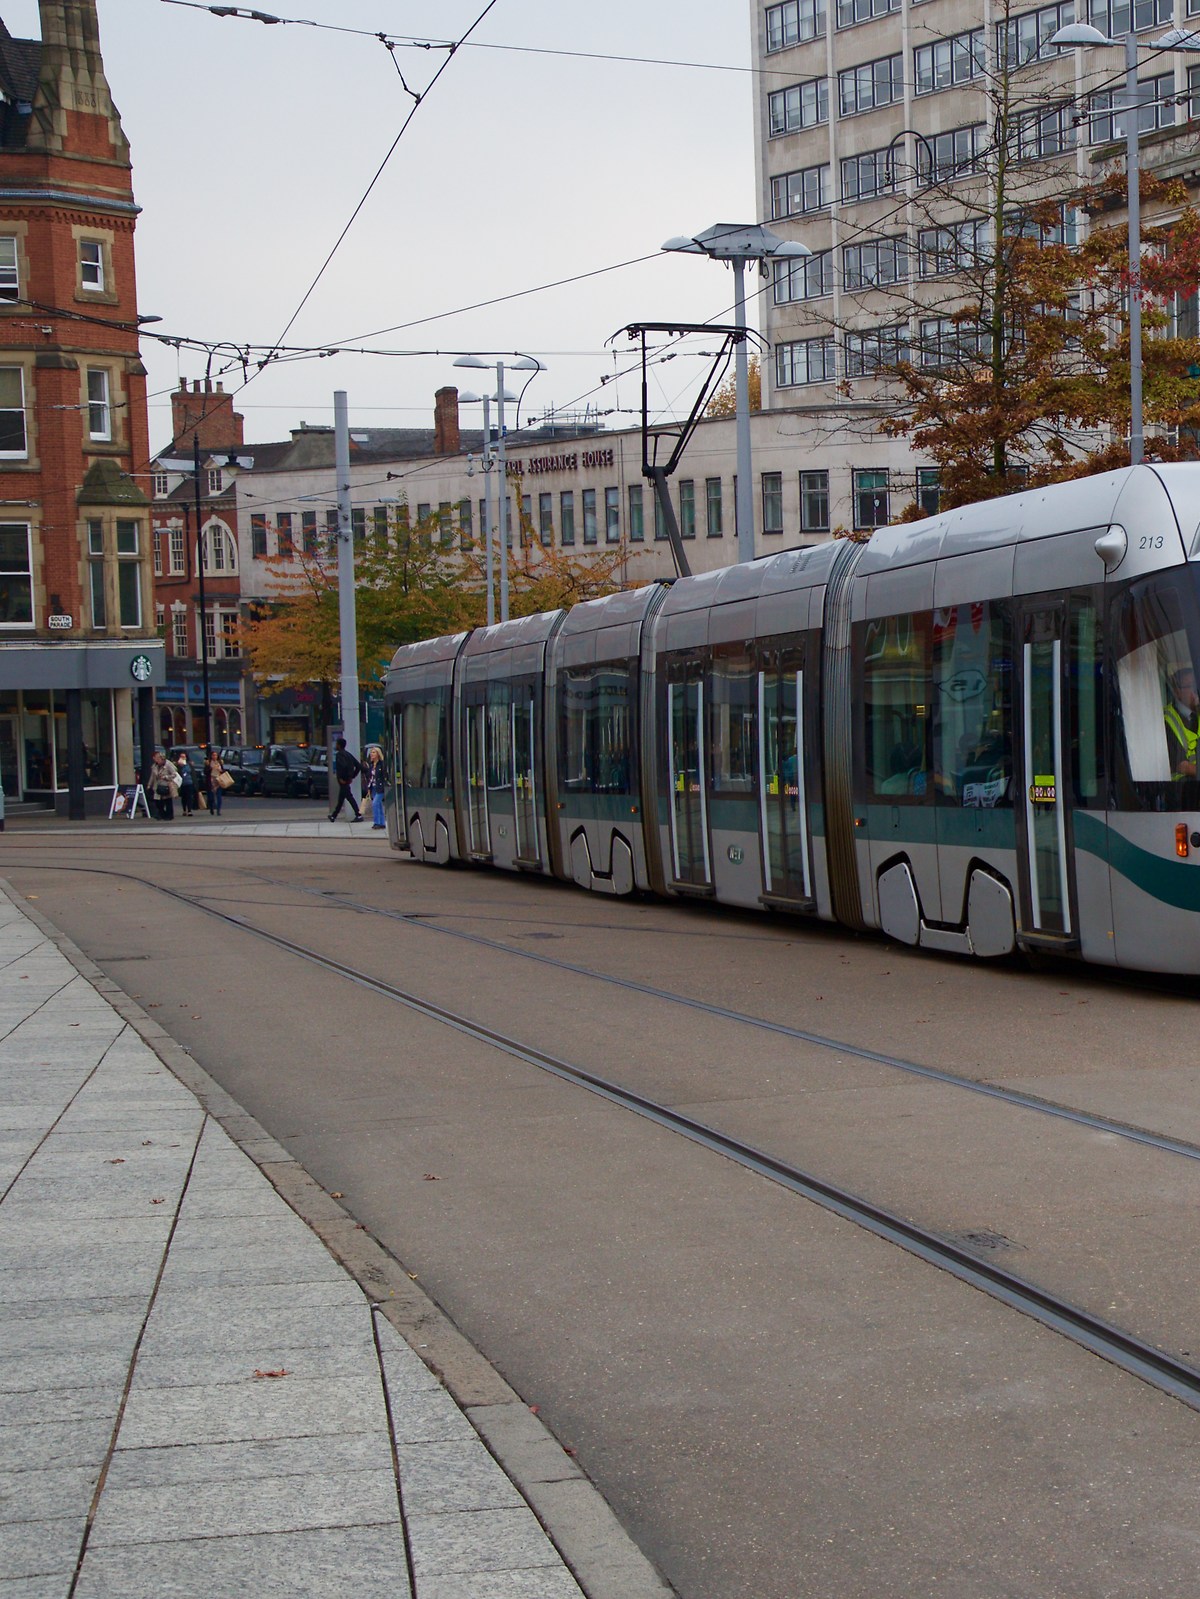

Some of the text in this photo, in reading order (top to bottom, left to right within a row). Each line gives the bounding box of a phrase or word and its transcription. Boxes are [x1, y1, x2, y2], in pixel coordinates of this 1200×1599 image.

[528, 453, 578, 474] ASSURANCE
[582, 449, 614, 469] HOUSE
[1139, 536, 1164, 549] 213
